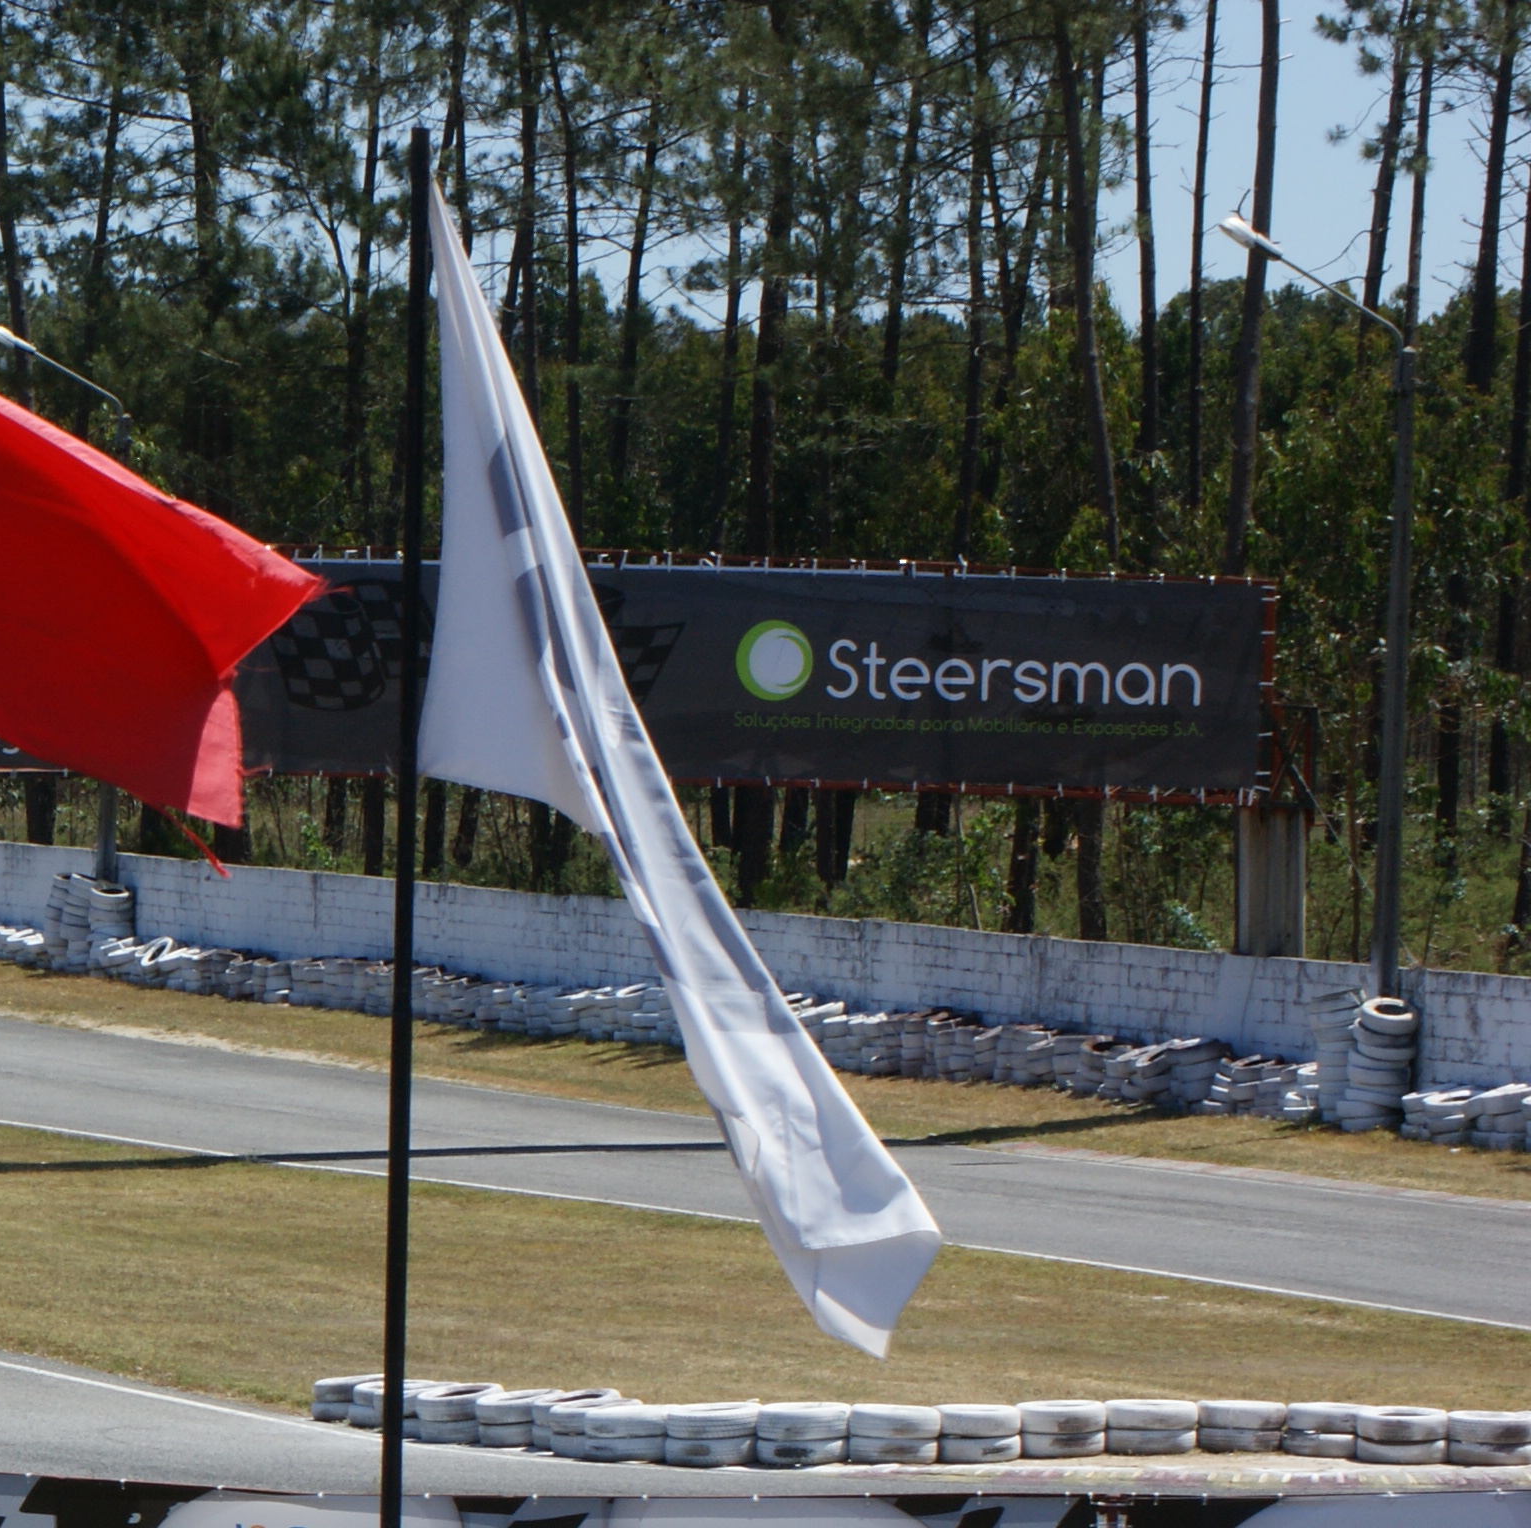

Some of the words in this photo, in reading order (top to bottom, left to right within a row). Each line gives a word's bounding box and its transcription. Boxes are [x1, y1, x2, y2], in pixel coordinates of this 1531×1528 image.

[824, 638, 1203, 707] Steersman
[816, 711, 916, 735] Integradas
[920, 717, 964, 735] para
[1057, 721, 1069, 735] e
